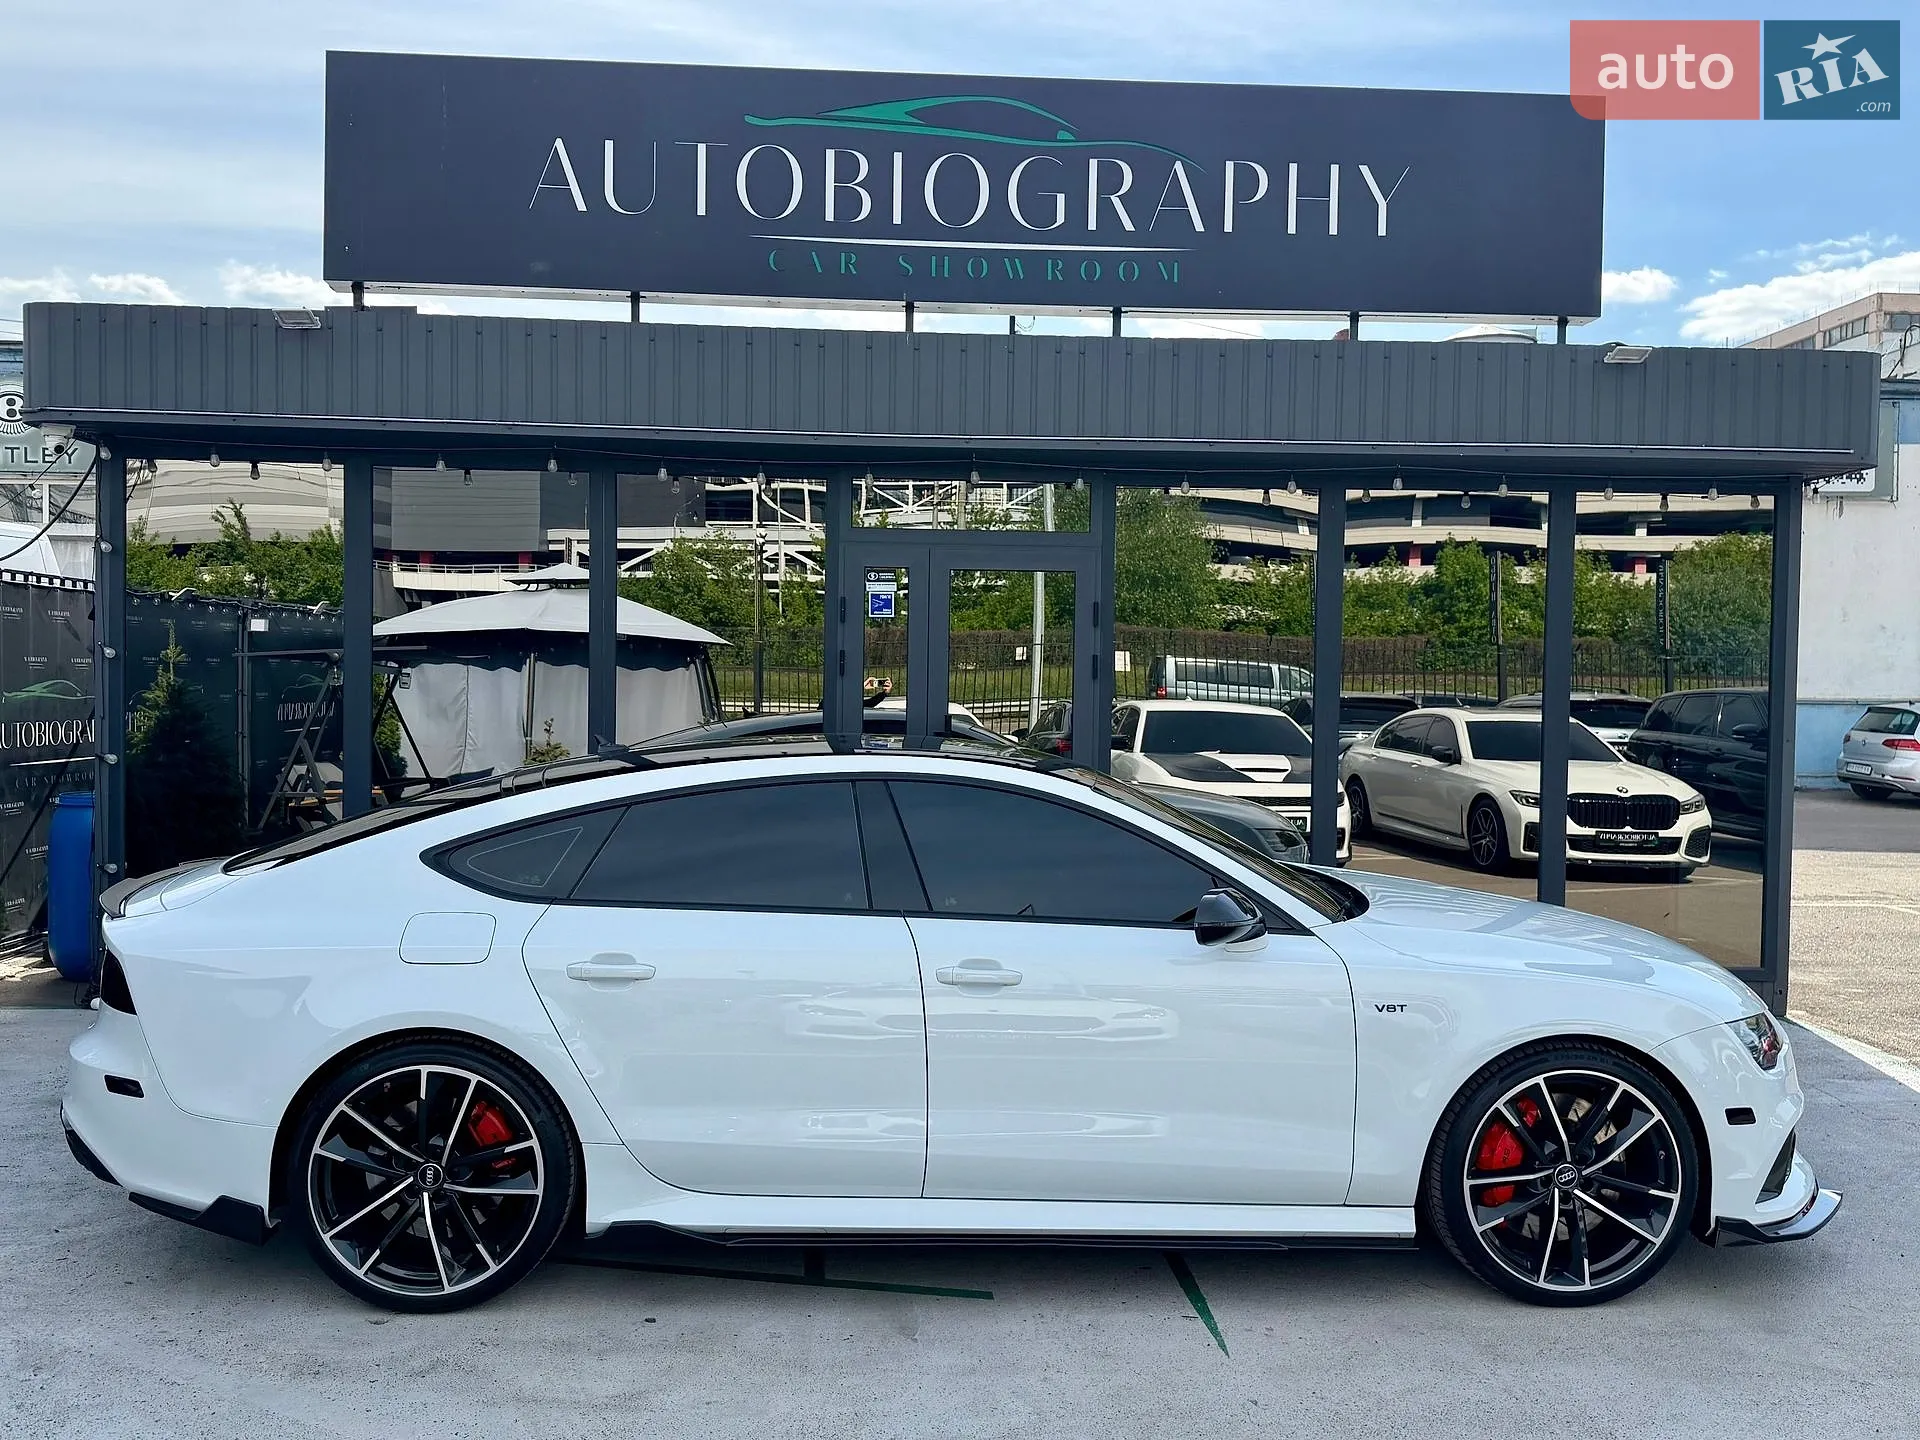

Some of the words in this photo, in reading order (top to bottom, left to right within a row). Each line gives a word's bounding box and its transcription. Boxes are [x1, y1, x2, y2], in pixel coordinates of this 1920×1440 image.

[528, 137, 1411, 237] AUTOBIOGRAPHY
[768, 248, 858, 275] CAR
[897, 253, 1180, 283] SHOWROOM
[1374, 1004, 1408, 1013] V8T
